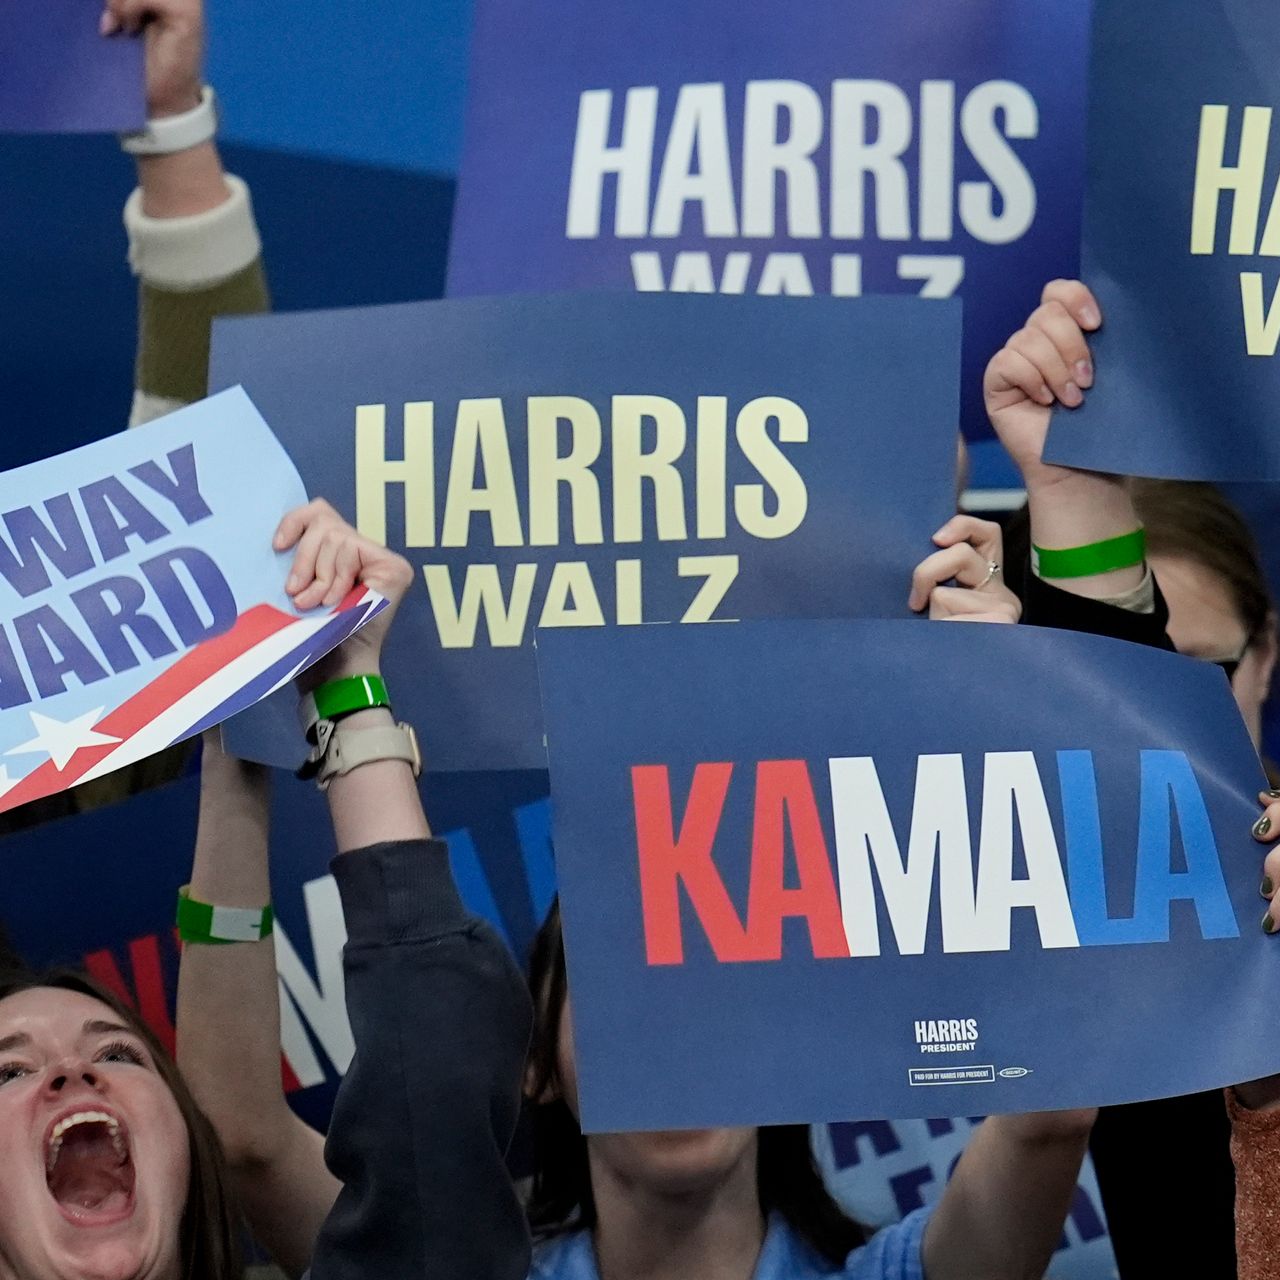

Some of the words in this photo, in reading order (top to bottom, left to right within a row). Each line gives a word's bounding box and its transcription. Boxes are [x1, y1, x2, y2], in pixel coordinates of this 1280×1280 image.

[566, 78, 1039, 245] HARRIS
[0, 442, 214, 599] WAY
[355, 394, 809, 548] HARRIS
[0, 546, 238, 711] ARD
[630, 748, 1241, 967] KAMALA
[914, 1018, 979, 1043] HARRIS
[920, 1042, 976, 1053] PRESIDENT
